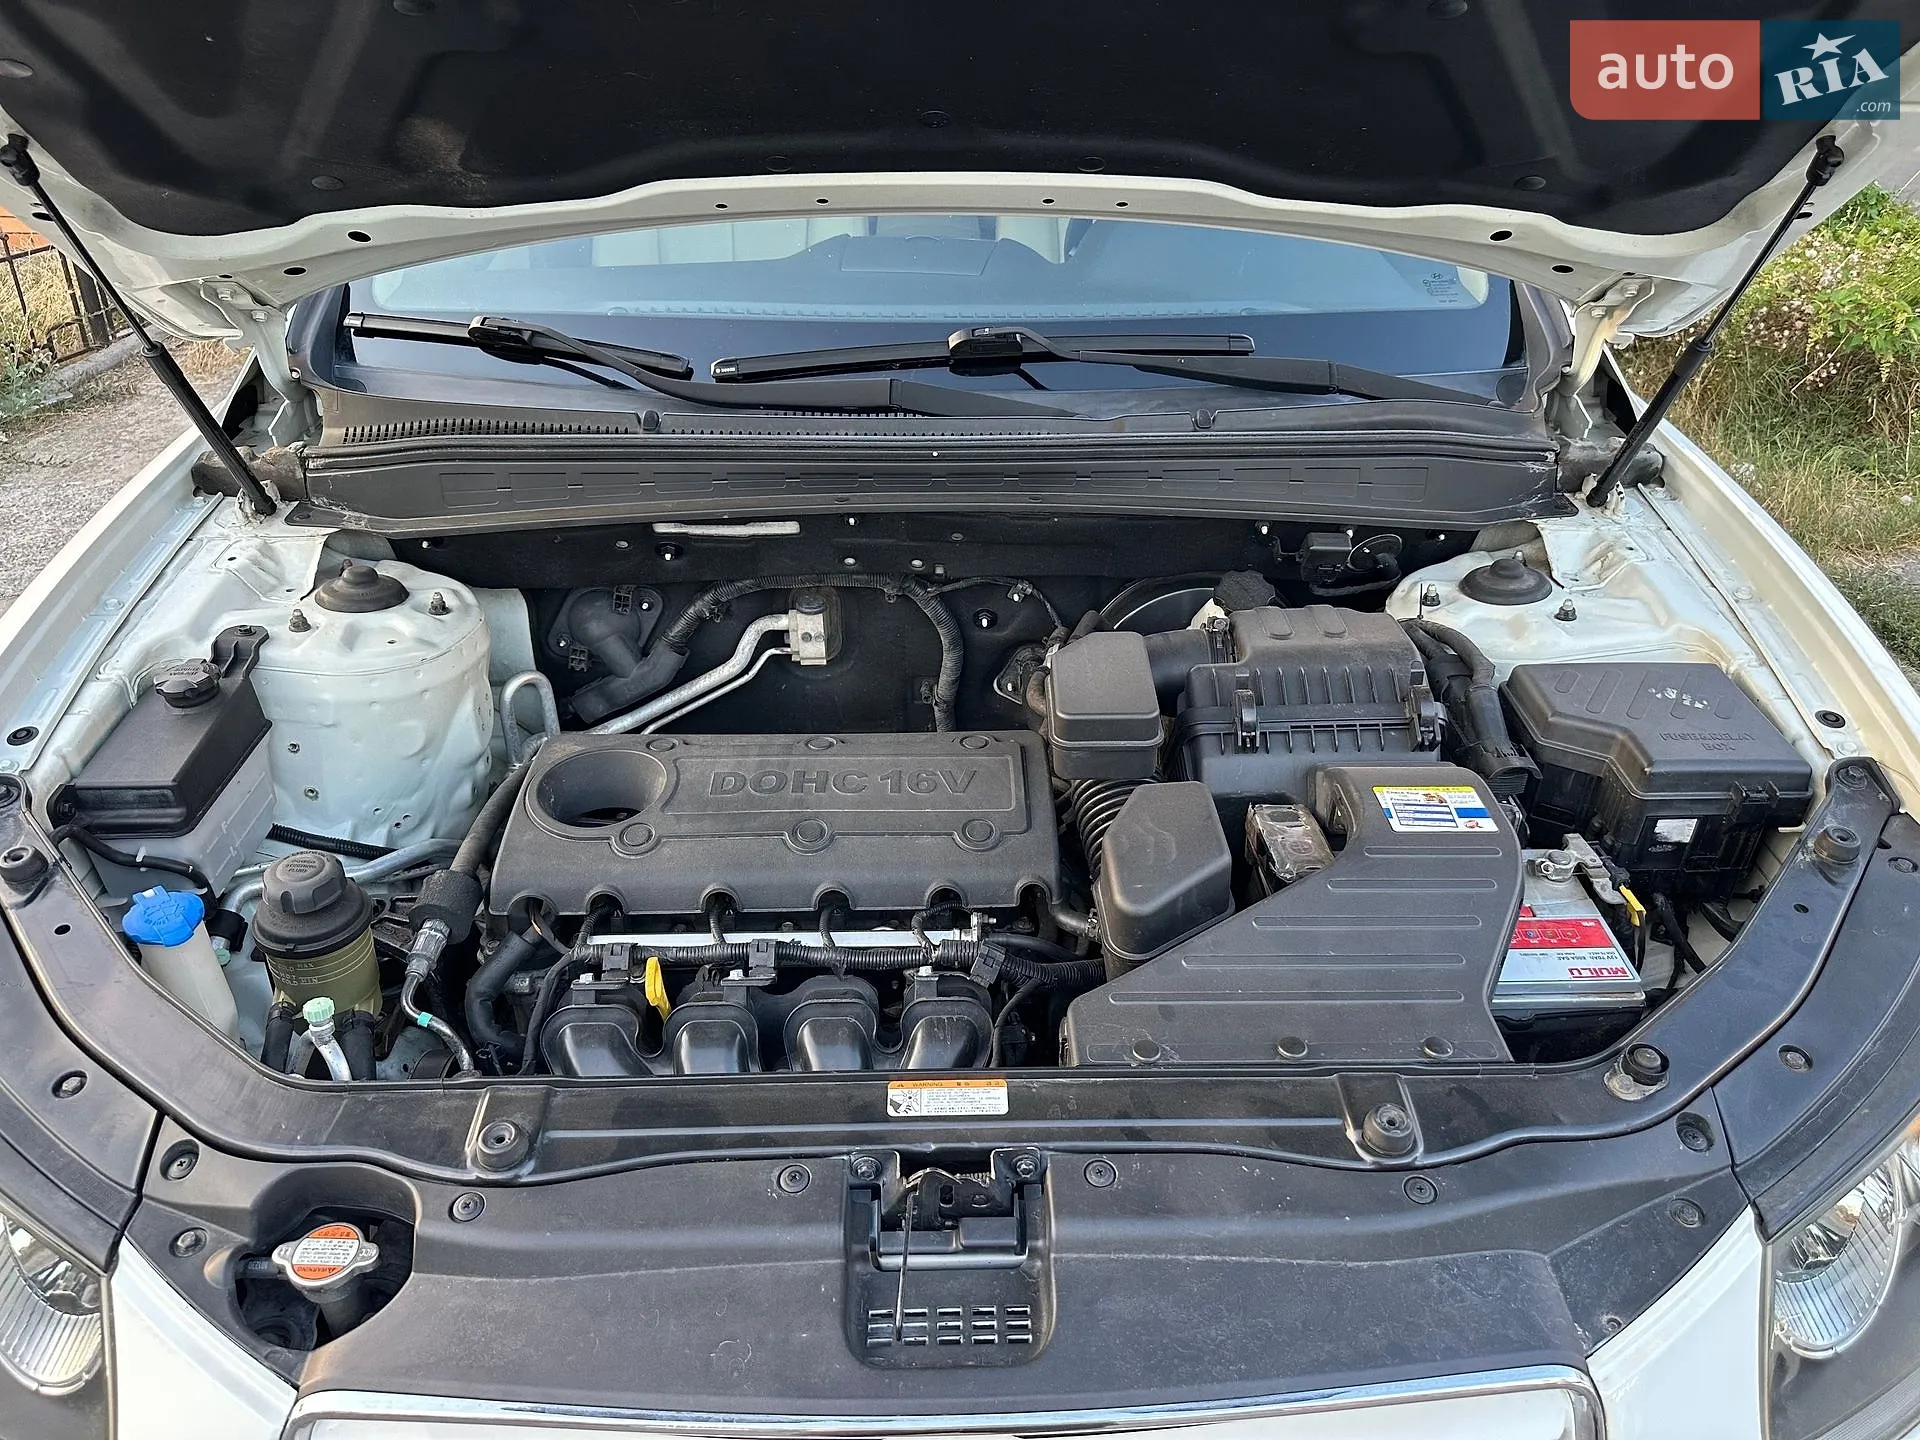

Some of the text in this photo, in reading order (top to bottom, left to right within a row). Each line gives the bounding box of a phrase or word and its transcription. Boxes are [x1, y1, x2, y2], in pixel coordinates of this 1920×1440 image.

[708, 768, 979, 797] DOHC 16V
[296, 1266, 327, 1274] WARNING
